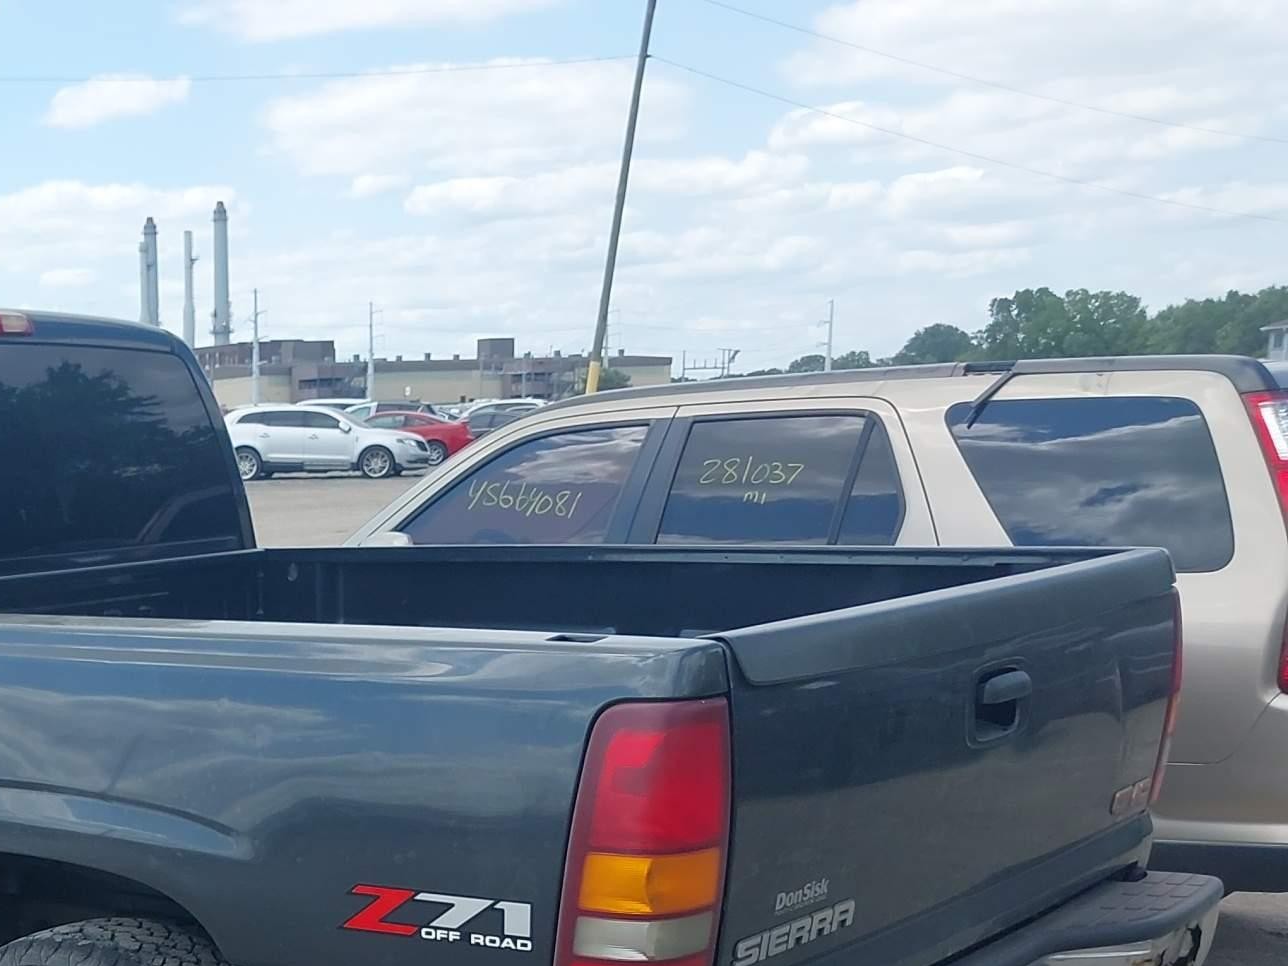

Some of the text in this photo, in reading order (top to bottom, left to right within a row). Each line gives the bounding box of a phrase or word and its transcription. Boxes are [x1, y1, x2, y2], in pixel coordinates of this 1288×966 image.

[699, 455, 805, 485] 281037
[343, 884, 532, 938] Z71
[420, 927, 533, 952] OFF ROAD
